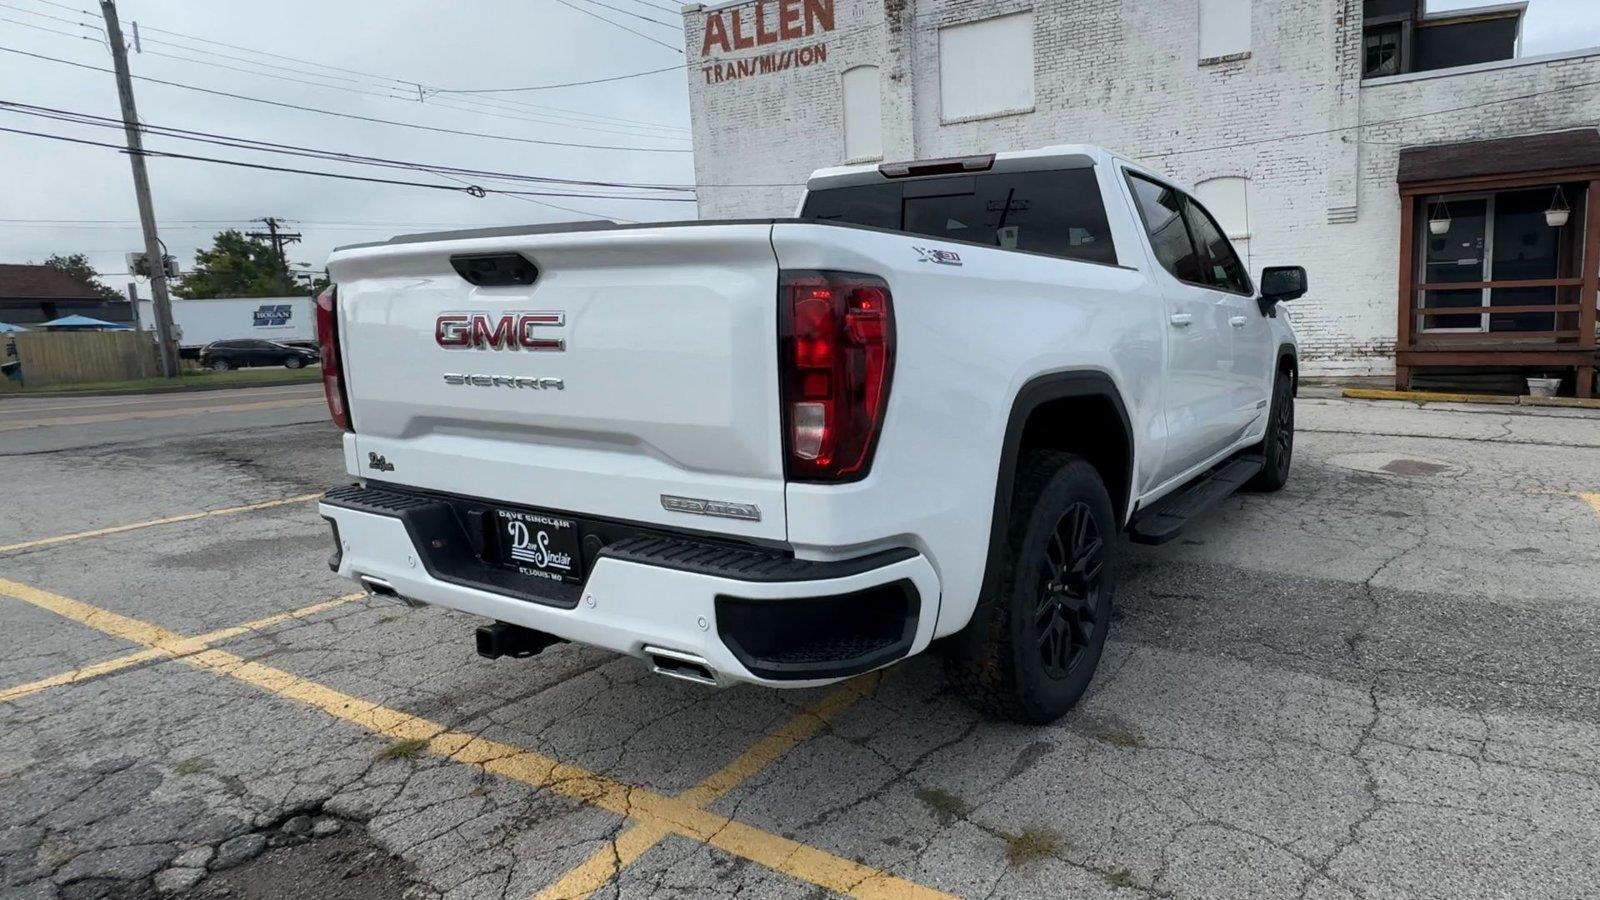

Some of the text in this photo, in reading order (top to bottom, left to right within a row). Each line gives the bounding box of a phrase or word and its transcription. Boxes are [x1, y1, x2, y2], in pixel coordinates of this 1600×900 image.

[701, 0, 835, 57] ALLEN
[702, 42, 827, 84] TRANSMISSION
[435, 310, 566, 352] GMC
[443, 372, 565, 390] SIERRA
[498, 509, 571, 528] DAVE SINCLAIR
[535, 530, 571, 568] Sinclair
[551, 572, 562, 581] MO
